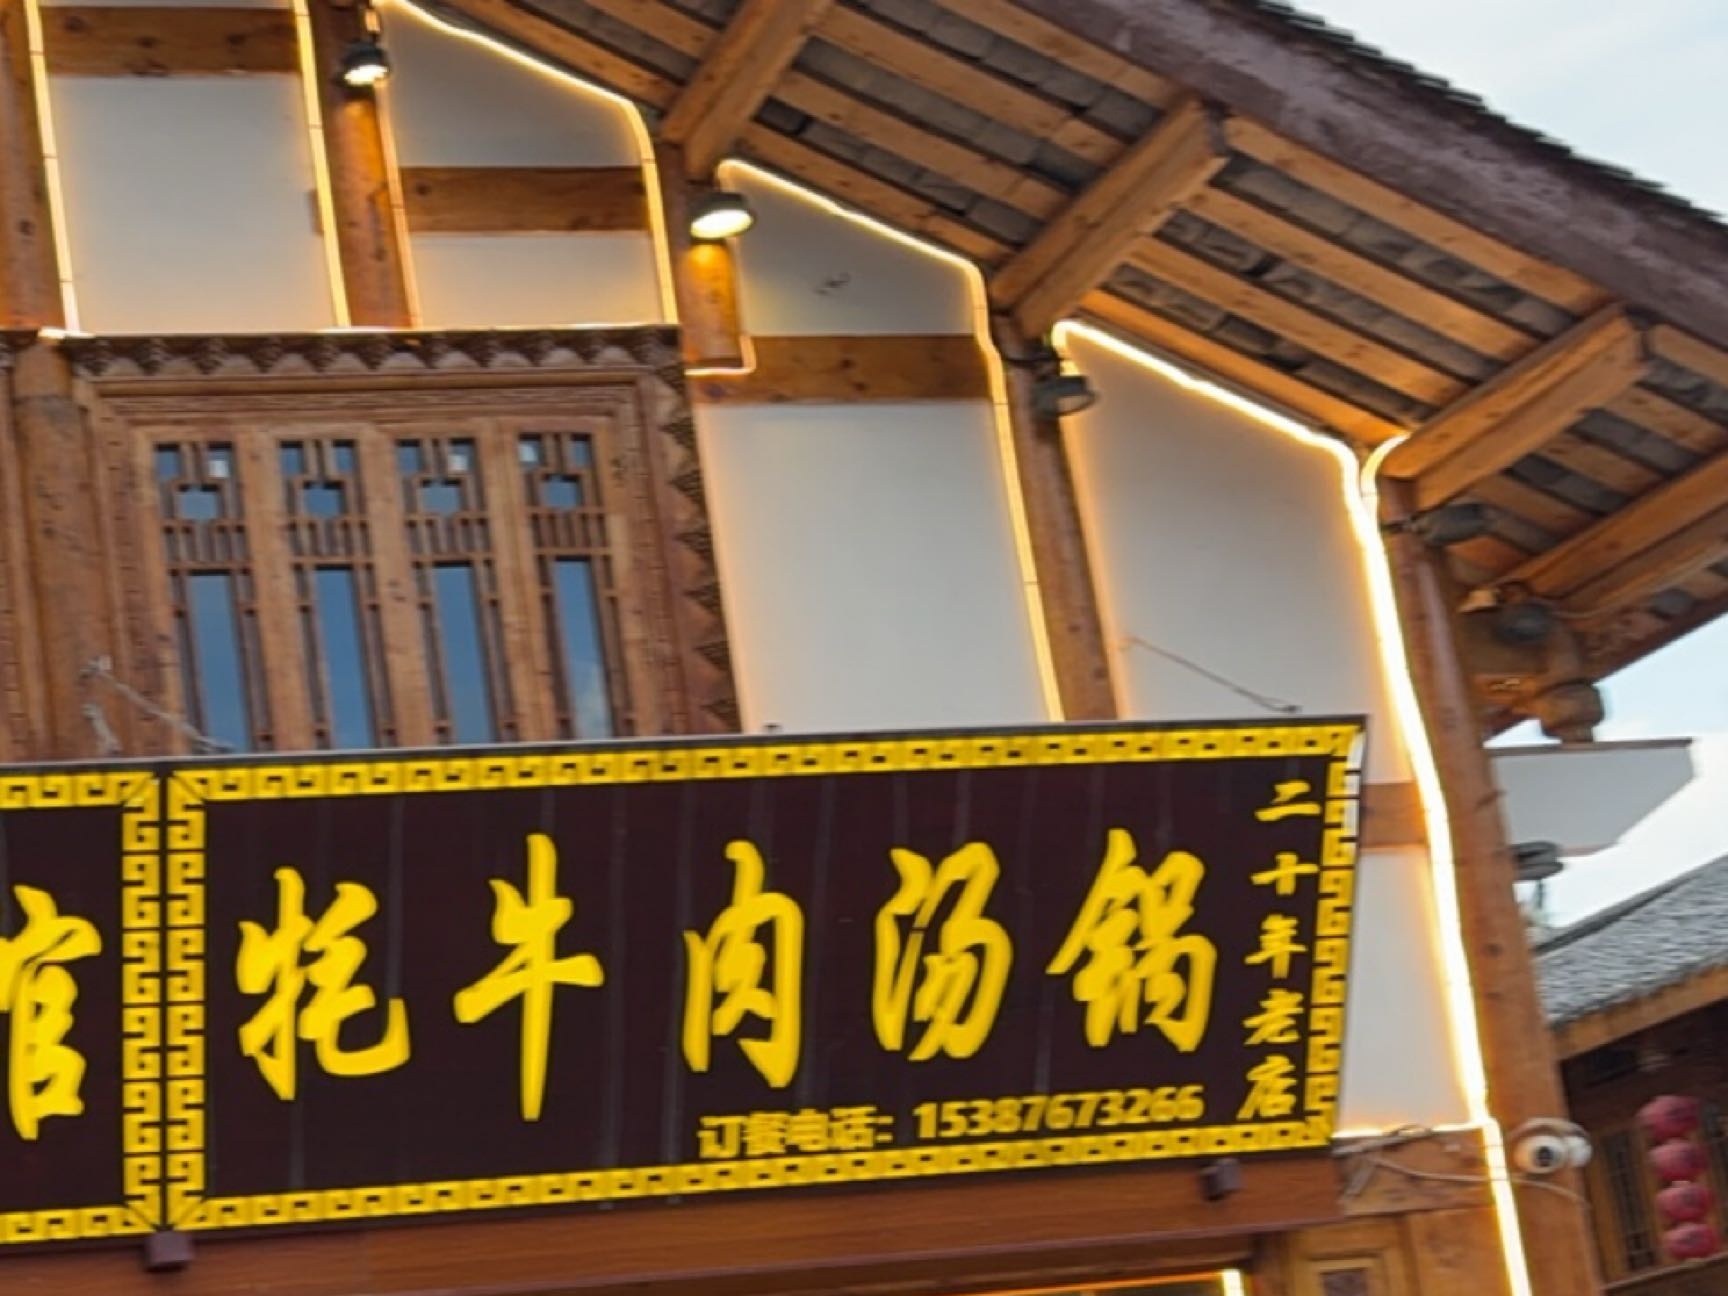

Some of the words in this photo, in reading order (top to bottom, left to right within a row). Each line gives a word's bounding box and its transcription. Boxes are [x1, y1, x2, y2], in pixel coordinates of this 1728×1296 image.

[236, 828, 1218, 1120] 牦牛肉汤锅
[1236, 780, 1322, 1121] 二十年老店
[913, 1085, 1205, 1139] 15387673266
